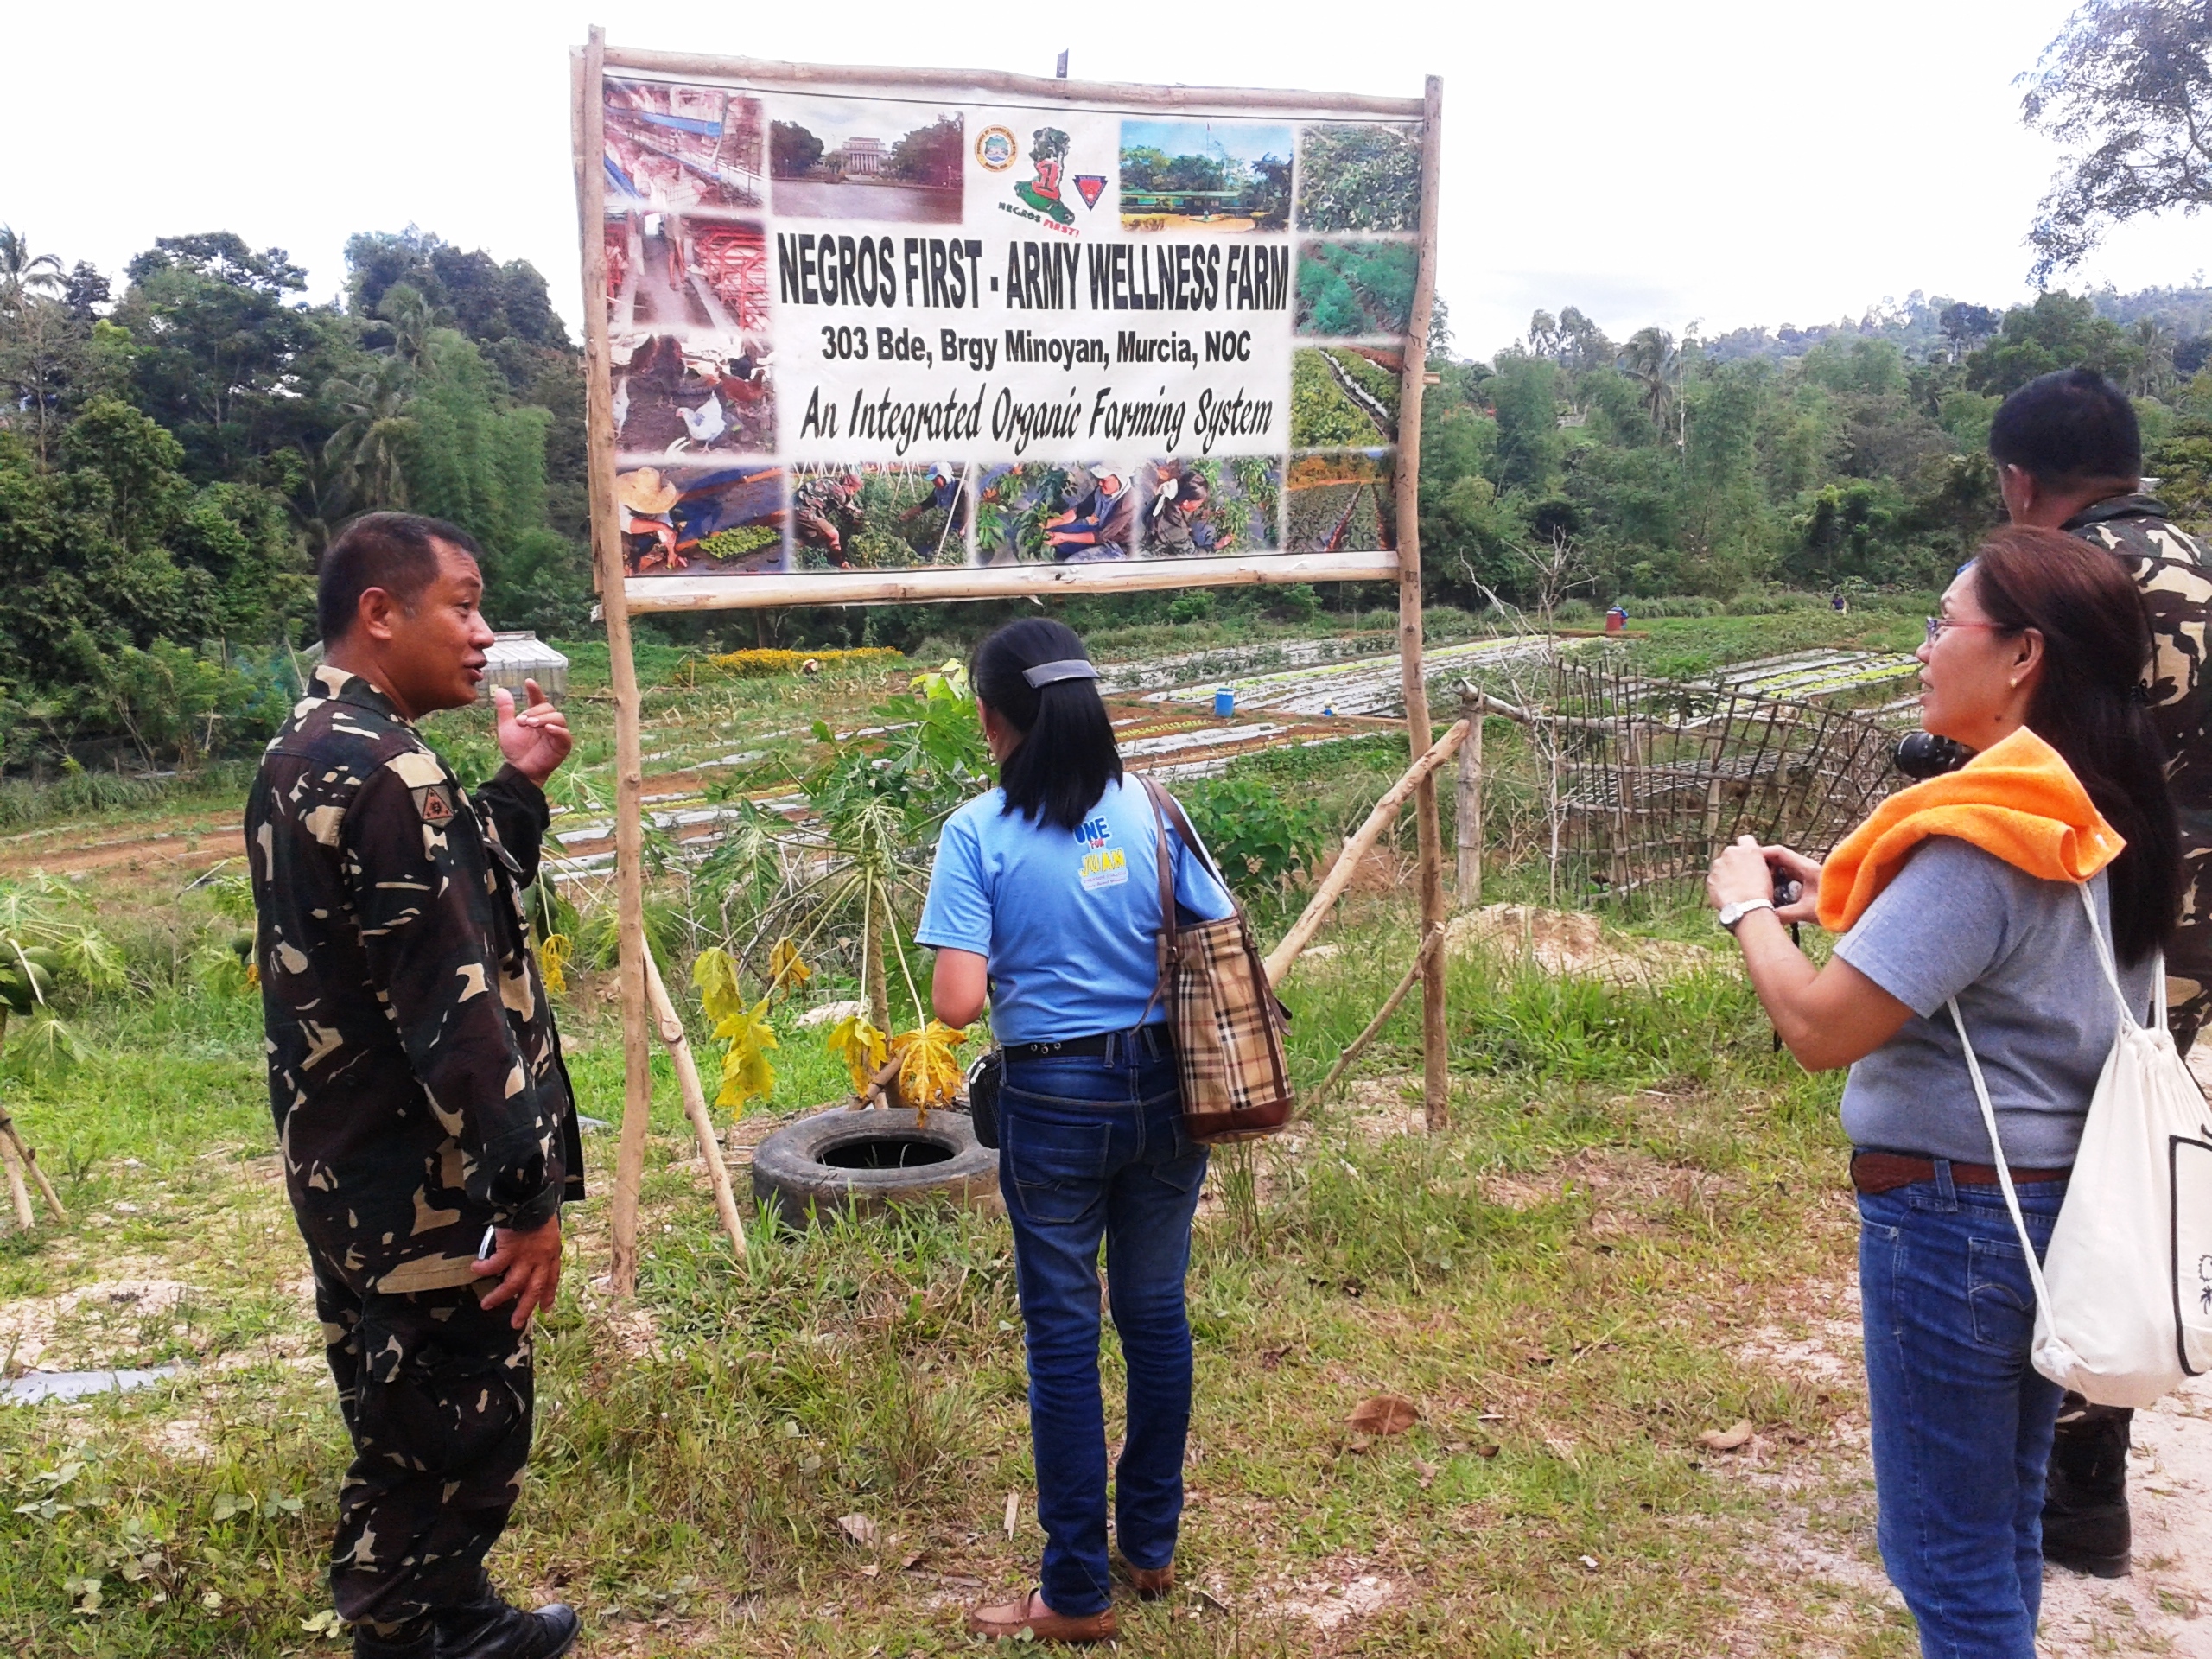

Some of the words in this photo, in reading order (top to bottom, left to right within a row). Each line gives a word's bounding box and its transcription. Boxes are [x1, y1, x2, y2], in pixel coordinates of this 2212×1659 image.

[998, 201, 1041, 223] NEGROS
[1043, 219, 1080, 238] FIRST!
[777, 232, 897, 308] NEGROS
[903, 237, 982, 309] FIRST
[1006, 240, 1082, 311] ARMY
[1087, 243, 1221, 312] WELLNESS
[1226, 245, 1289, 311] FARM
[821, 325, 869, 360] 303
[876, 327, 932, 370] Bde,
[940, 328, 999, 372] Brgy
[1005, 329, 1109, 372] Minoyan,
[1116, 331, 1198, 370] Murcia,
[1205, 330, 1252, 363] NOC
[799, 385, 839, 440] An
[849, 383, 987, 457] Integrated
[991, 385, 1083, 457] Organic
[1089, 385, 1187, 454] Farming
[1193, 387, 1274, 456] System
[1073, 817, 1110, 844] ONE
[1090, 837, 1105, 849] FOR
[1080, 849, 1127, 877] JUAN
